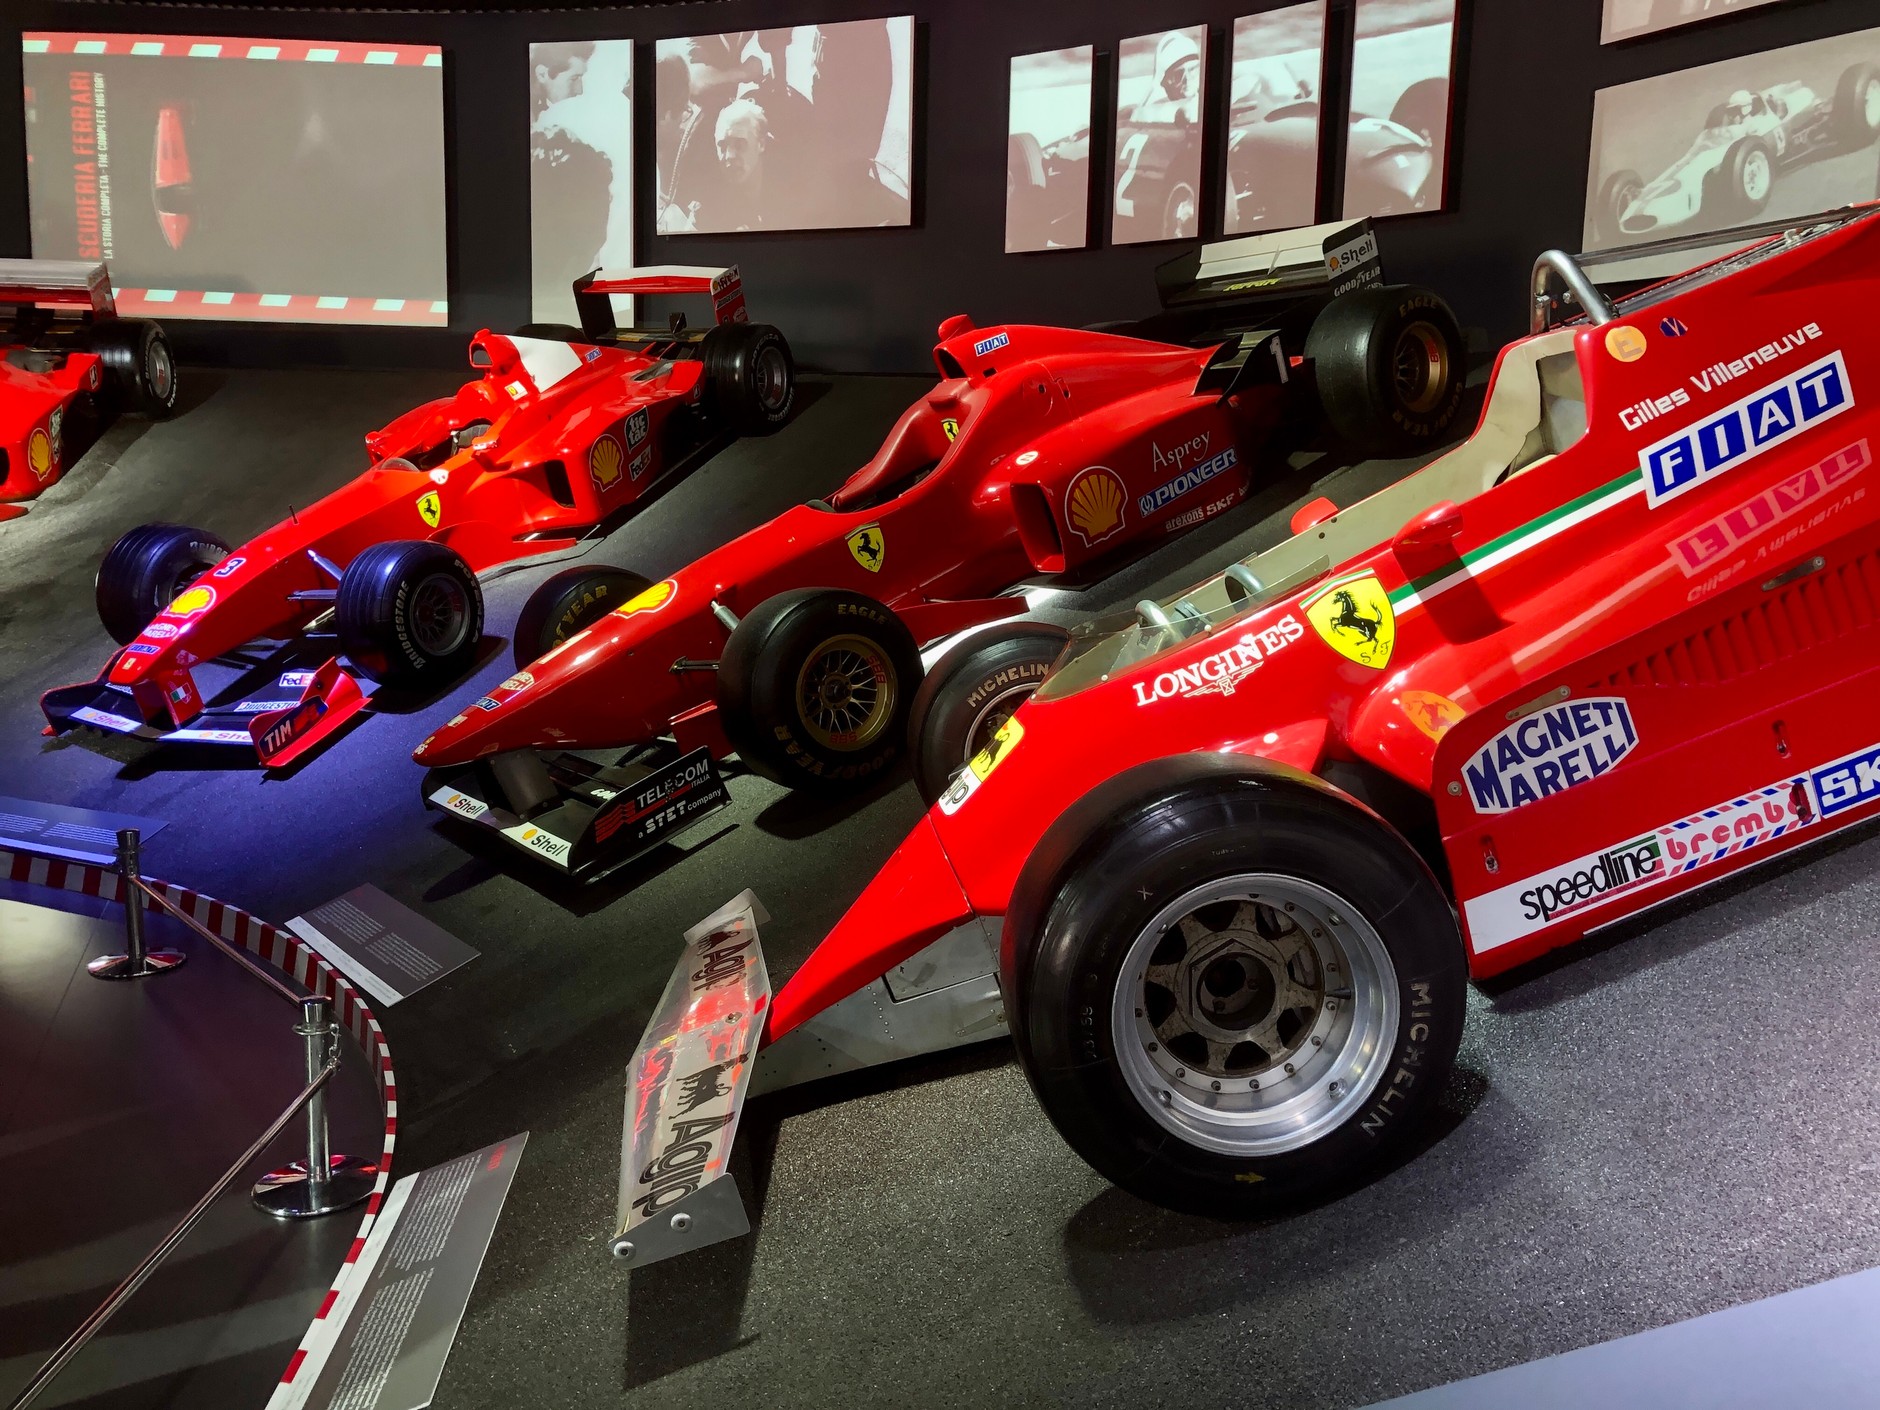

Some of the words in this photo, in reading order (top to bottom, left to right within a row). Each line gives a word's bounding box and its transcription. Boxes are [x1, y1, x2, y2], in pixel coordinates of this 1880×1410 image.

[93, 72, 105, 107] HISTORY
[69, 71, 96, 156] FERRARI
[96, 108, 108, 151] COMPLETE
[98, 153, 108, 168] THE
[1116, 133, 1149, 217] 2
[74, 161, 100, 259] SCUDERIA
[100, 175, 111, 217] COMPLETA
[102, 217, 113, 248] STORIA
[1340, 239, 1373, 266] Shell
[104, 249, 114, 260] LA
[1334, 266, 1381, 297] GOODYEAR
[977, 334, 1009, 355] FIAT
[1269, 336, 1289, 384] 1
[1618, 387, 1690, 432] Gilles
[1690, 322, 1823, 393] Villeneuve
[628, 426, 646, 445] tac
[629, 415, 645, 430] tic
[1661, 370, 1832, 487] FIAT
[1152, 431, 1210, 473] Asprey
[1155, 448, 1238, 506] PIONEER
[1165, 508, 1204, 530] arexons
[1206, 493, 1235, 516] SKF
[214, 558, 246, 577] 3
[395, 580, 426, 669] BRIDGESTONE
[837, 604, 889, 625] EAGLE
[1133, 615, 1304, 706] LONGINES
[966, 663, 1049, 708] MICHELIN
[98, 715, 129, 727] Shell
[264, 719, 292, 752] TIM
[1466, 701, 1637, 809] MAGNETI
[637, 758, 709, 808] TELECOM
[691, 774, 711, 788] ITALIA
[453, 797, 486, 816] Shell
[638, 831, 644, 839] a
[645, 801, 687, 834] STET
[687, 788, 722, 812] company
[531, 834, 570, 857] Shell
[1520, 844, 1657, 922] speedline
[1359, 982, 1432, 1138] MICHELIN
[632, 1111, 736, 1218] Agip
